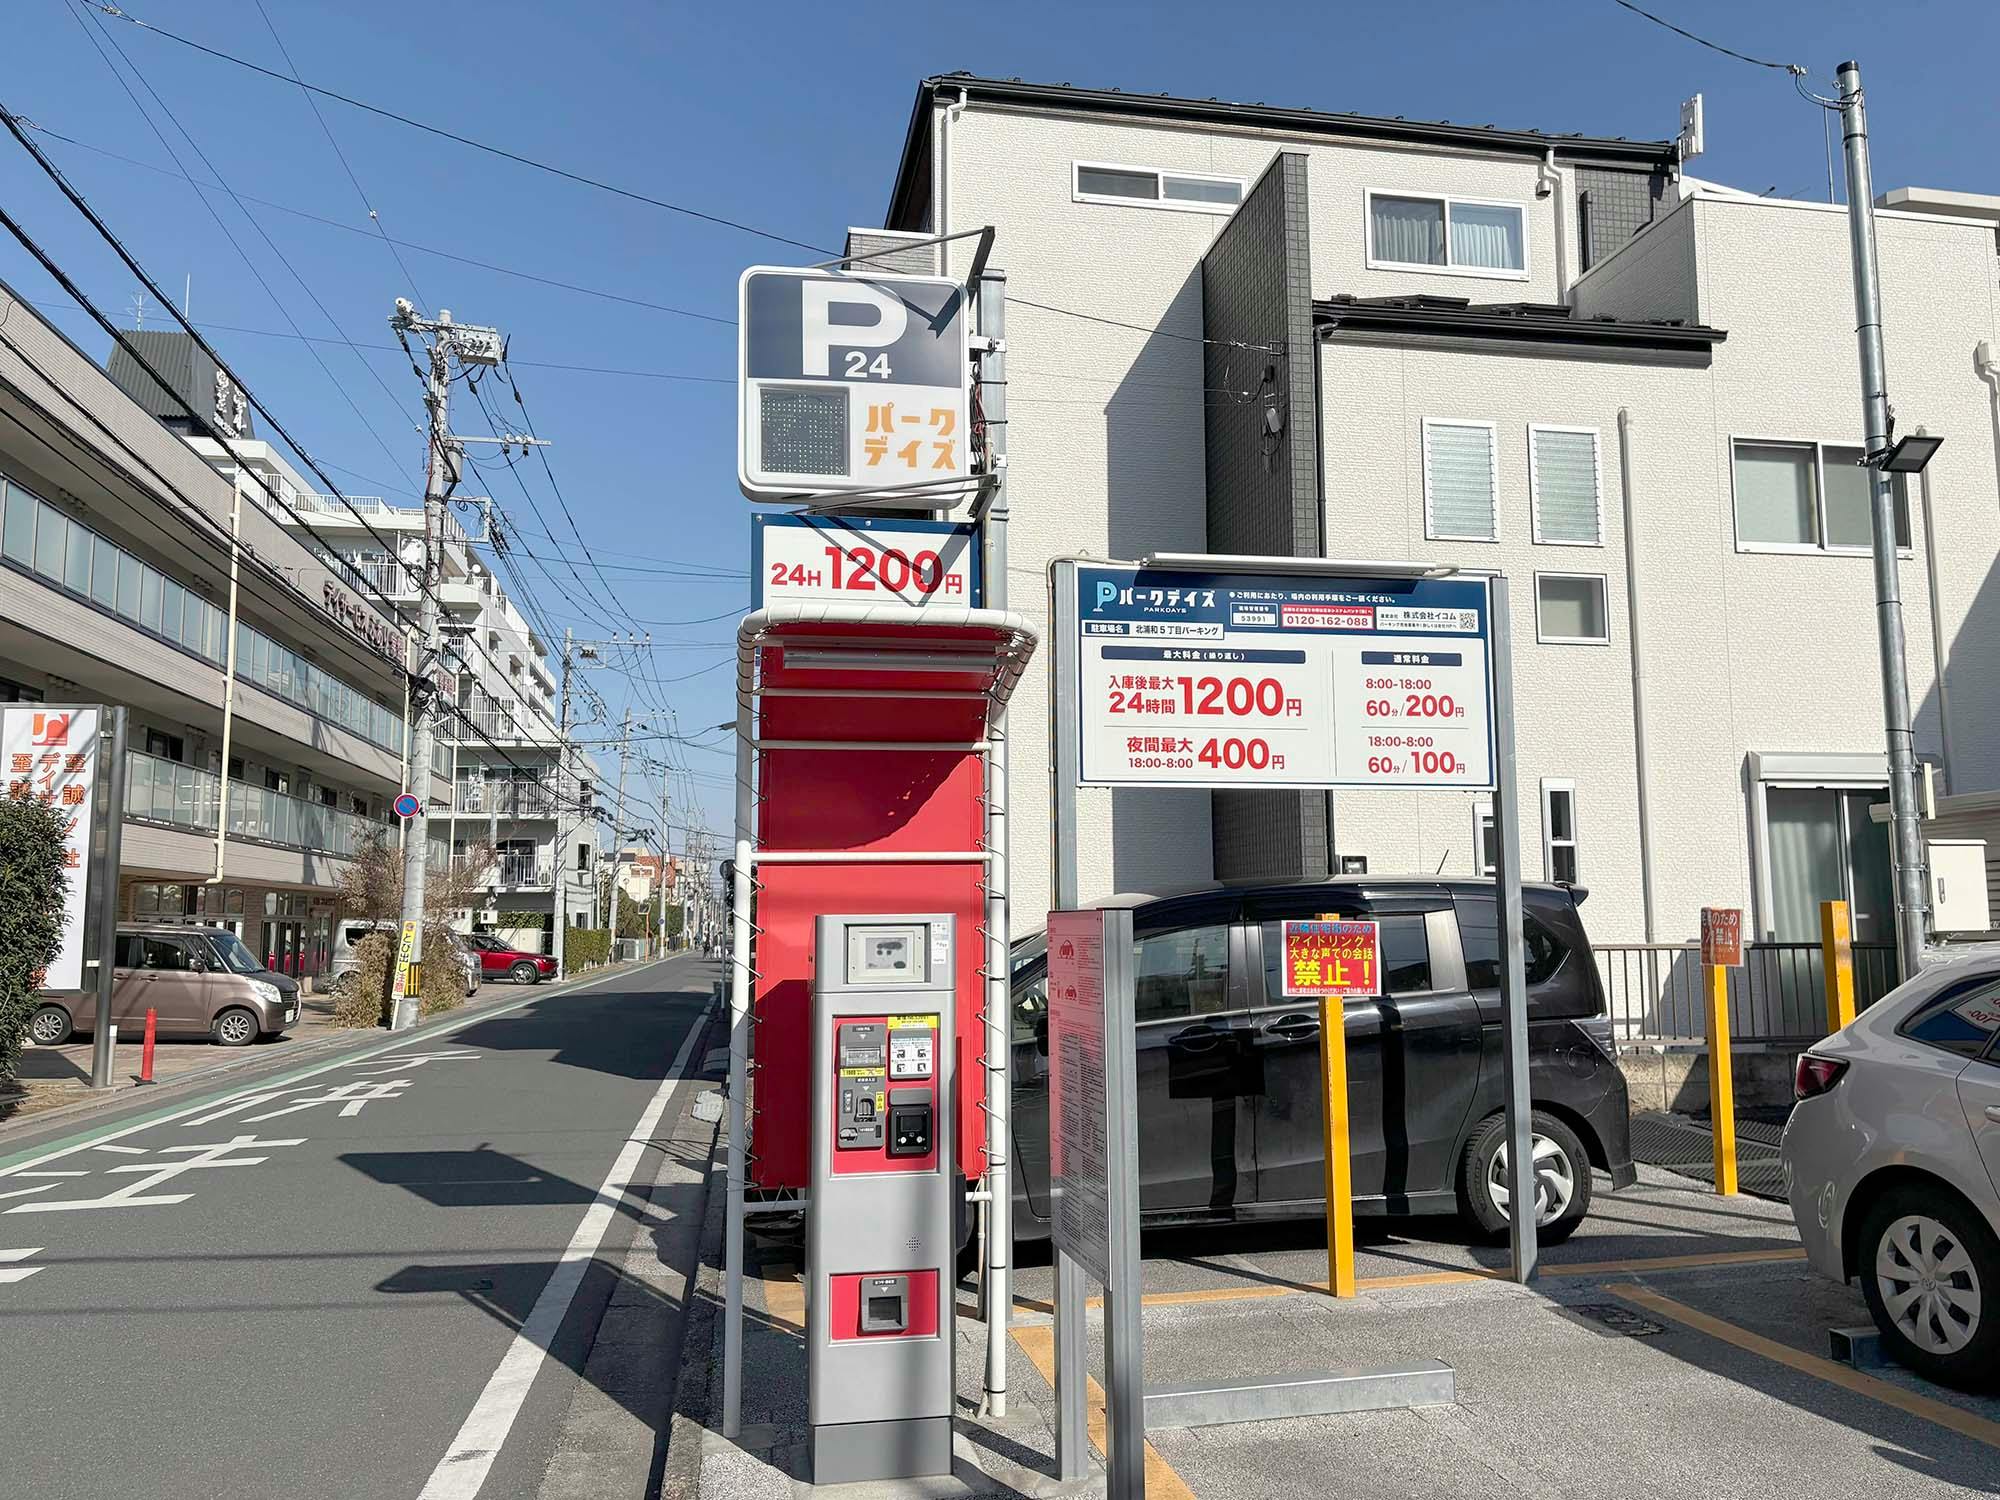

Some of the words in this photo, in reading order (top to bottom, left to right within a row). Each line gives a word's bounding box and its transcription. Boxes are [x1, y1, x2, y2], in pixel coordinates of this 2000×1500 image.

[802, 280, 908, 377] P
[845, 351, 892, 379] 24
[865, 403, 956, 436] パーク
[864, 437, 956, 470] デイズ
[1120, 587, 1217, 608] パークデイズ
[1091, 624, 1123, 634] 駐車場名
[1286, 615, 1368, 627] 0120-162-088
[1163, 649, 1201, 661] 最大料金
[1393, 653, 1430, 664] 通常料金
[1108, 675, 1175, 692] 入庫後最大
[1366, 678, 1432, 690] 8:00-18:00
[1109, 691, 1175, 715] 24時間
[1178, 676, 1303, 717] 1200円
[1127, 737, 1193, 753] 夜間最大
[1368, 736, 1433, 748] 18:00-8:00
[1129, 757, 1193, 769] 18:00-8:00
[1198, 738, 1285, 771] 400円
[1289, 947, 1374, 960] 大きな声での会話
[1294, 959, 1371, 986] 禁止!
